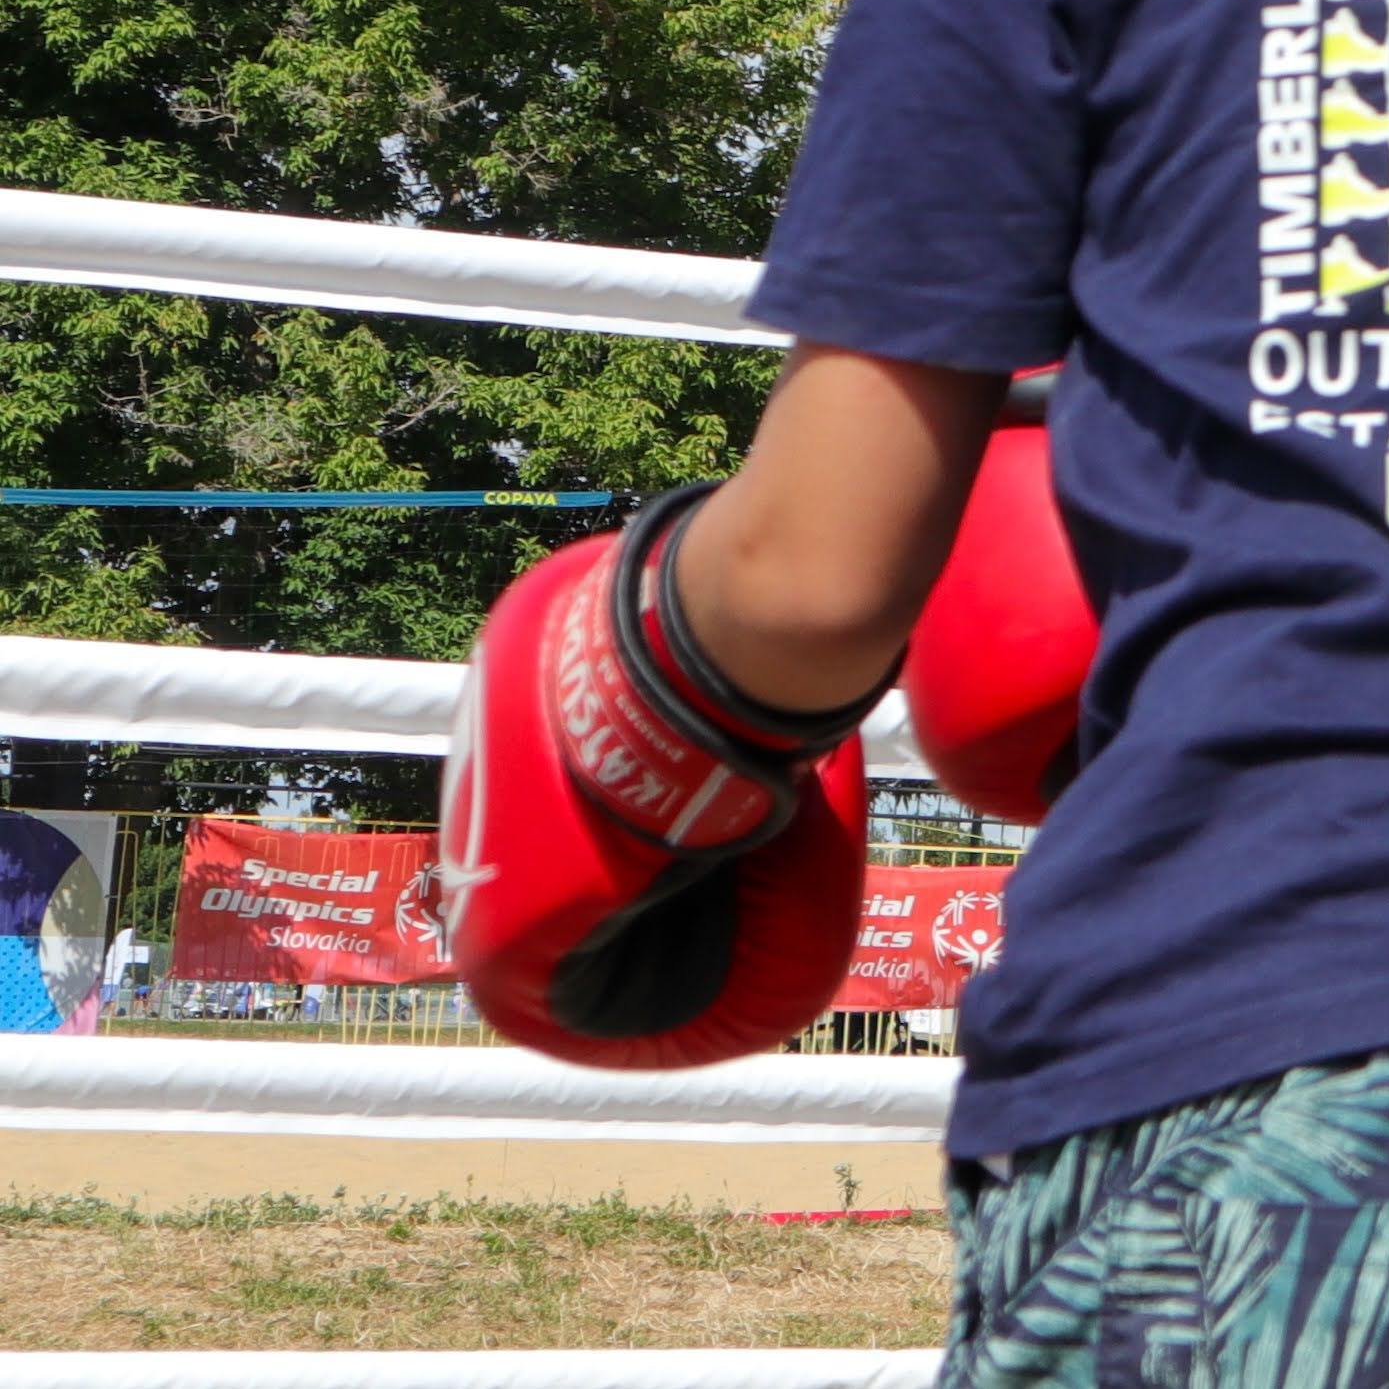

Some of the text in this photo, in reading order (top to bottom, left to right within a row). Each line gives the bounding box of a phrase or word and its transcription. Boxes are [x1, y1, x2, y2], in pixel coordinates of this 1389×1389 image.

[483, 491, 558, 506] COPAYA
[240, 858, 379, 893] Special
[200, 887, 375, 925] Olympics
[266, 926, 371, 954] Slovakia
[848, 956, 912, 979] vakia
